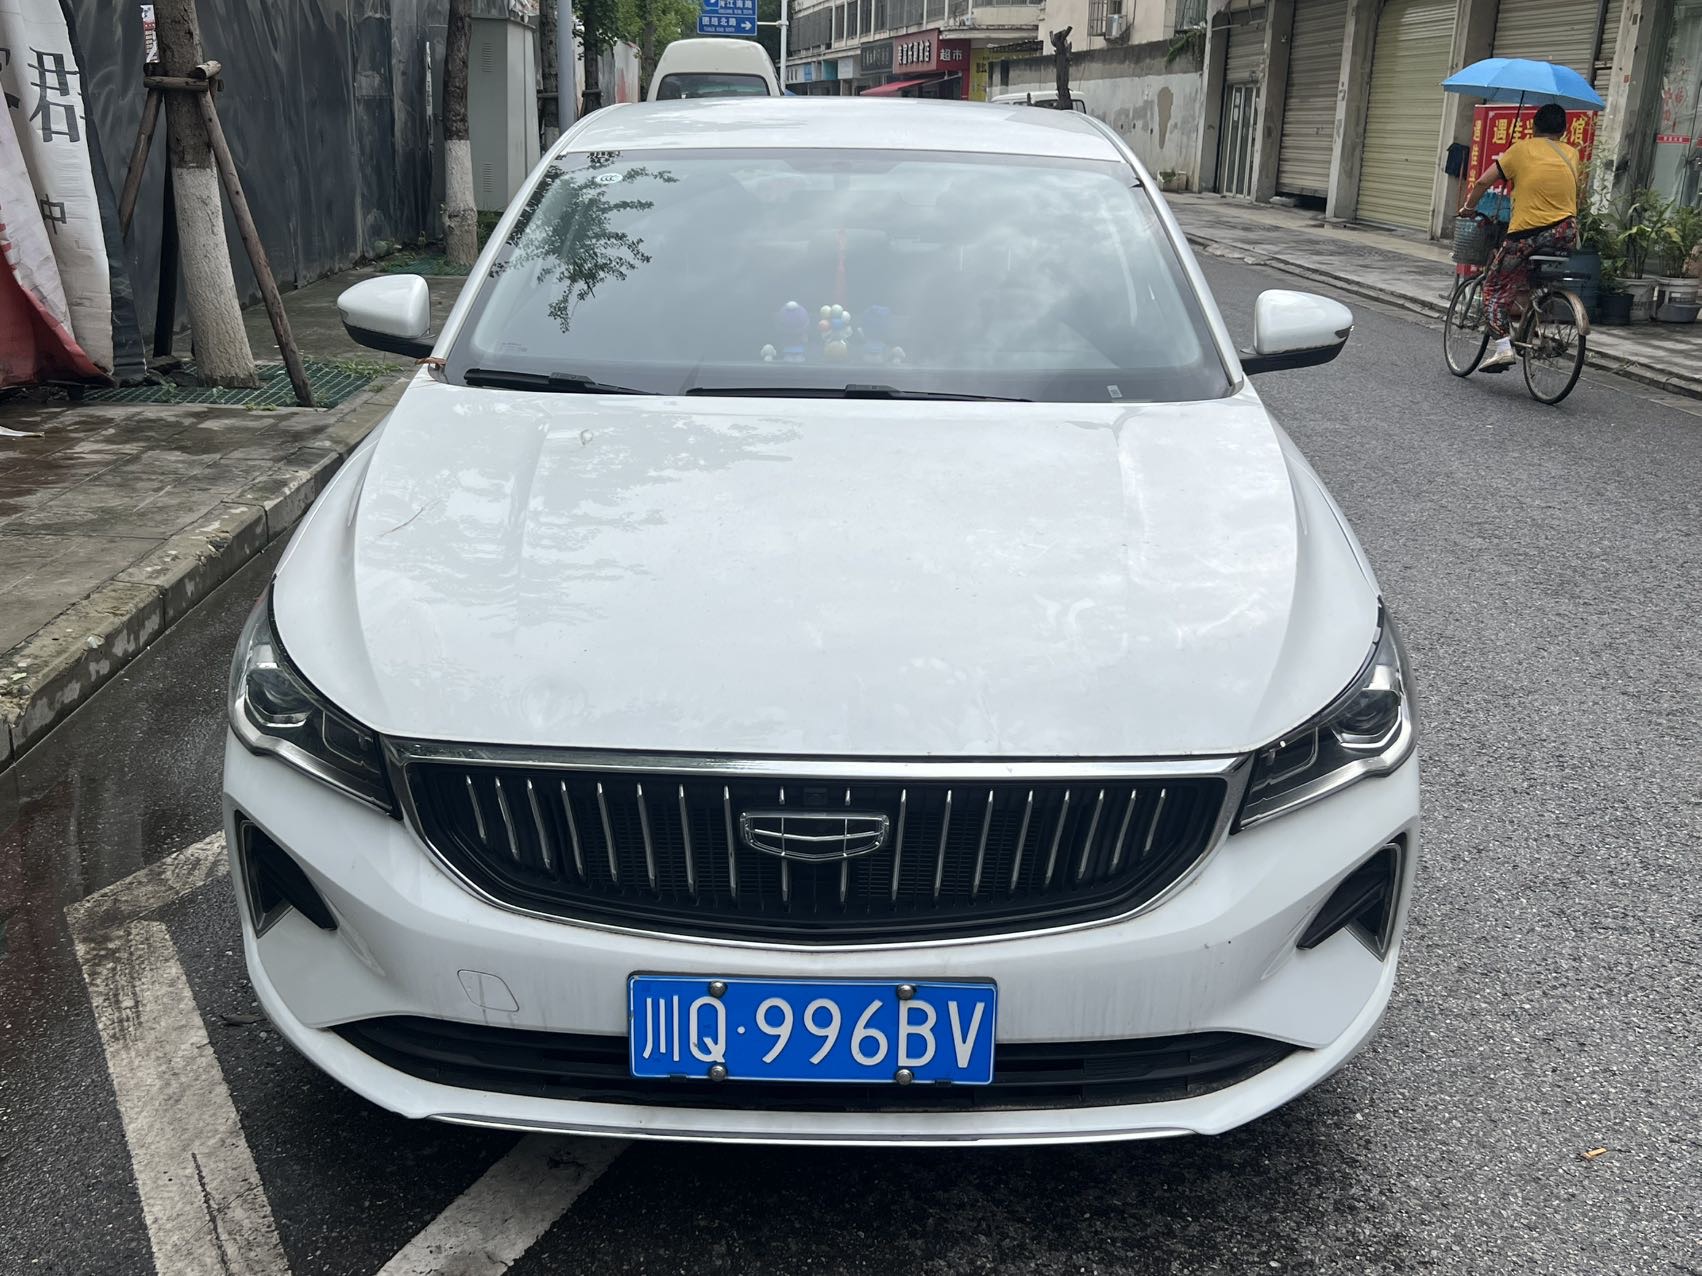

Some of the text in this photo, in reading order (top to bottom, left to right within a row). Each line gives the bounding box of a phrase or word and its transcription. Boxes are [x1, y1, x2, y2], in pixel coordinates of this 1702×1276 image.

[940, 48, 962, 61] 超市
[40, 193, 67, 235] 中
[643, 995, 985, 1069] 川Q·996BV
